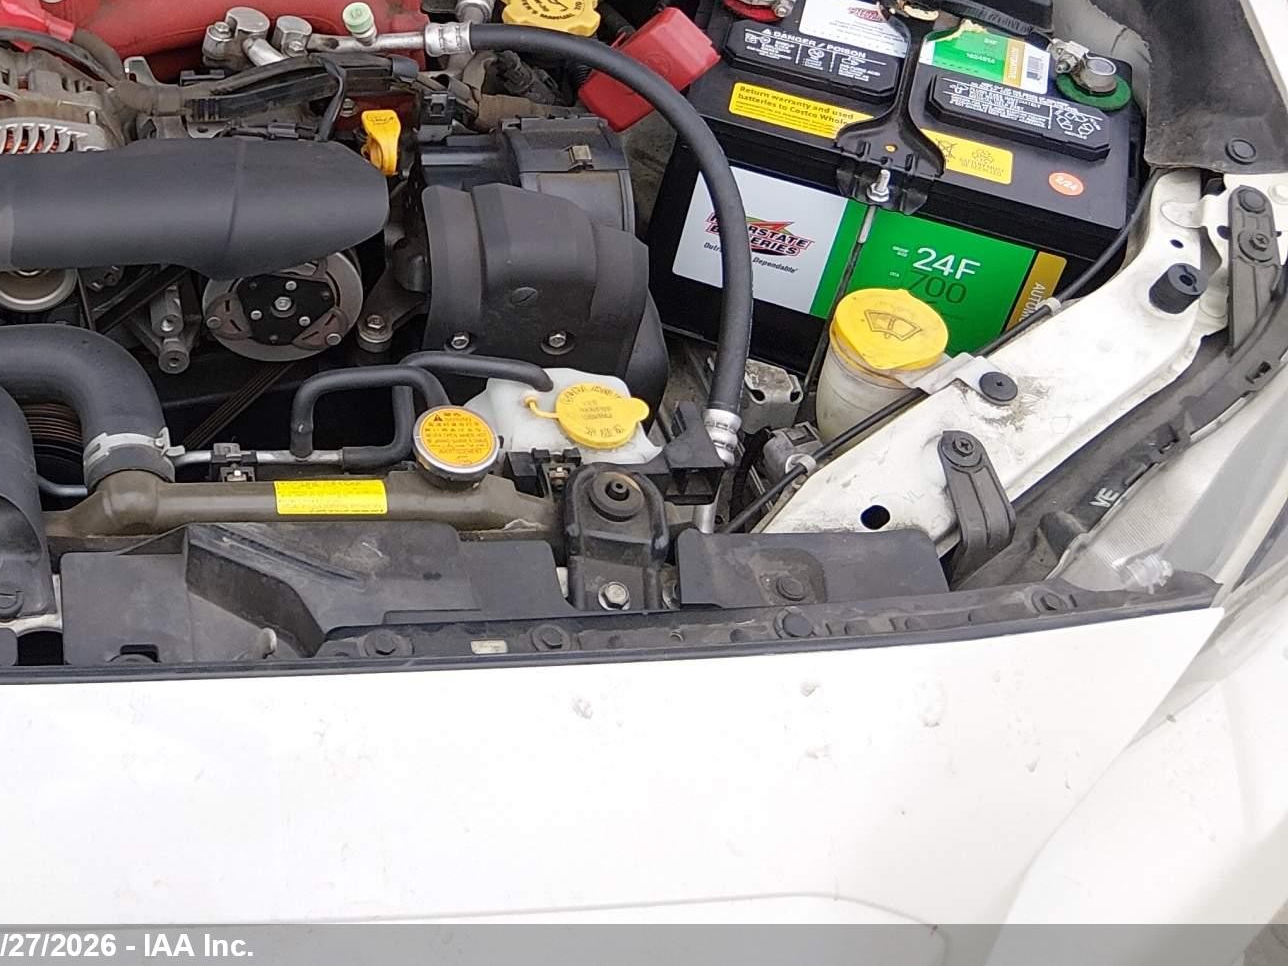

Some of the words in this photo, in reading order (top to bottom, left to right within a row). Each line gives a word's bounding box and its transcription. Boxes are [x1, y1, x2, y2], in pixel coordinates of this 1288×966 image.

[773, 32, 817, 49] DANGER
[827, 44, 866, 59] POISON
[737, 93, 777, 108] batteries
[778, 103, 789, 111] to
[789, 106, 818, 119] Costco
[819, 114, 849, 125] Whole
[739, 86, 770, 98] Return
[771, 95, 812, 110] warranty
[813, 105, 831, 114] and
[832, 109, 854, 120] used
[708, 212, 812, 248] IRSTATE
[708, 225, 799, 255] BERIES
[752, 257, 795, 273] Dependable
[913, 247, 981, 280] 24F
[909, 271, 967, 304] 700
